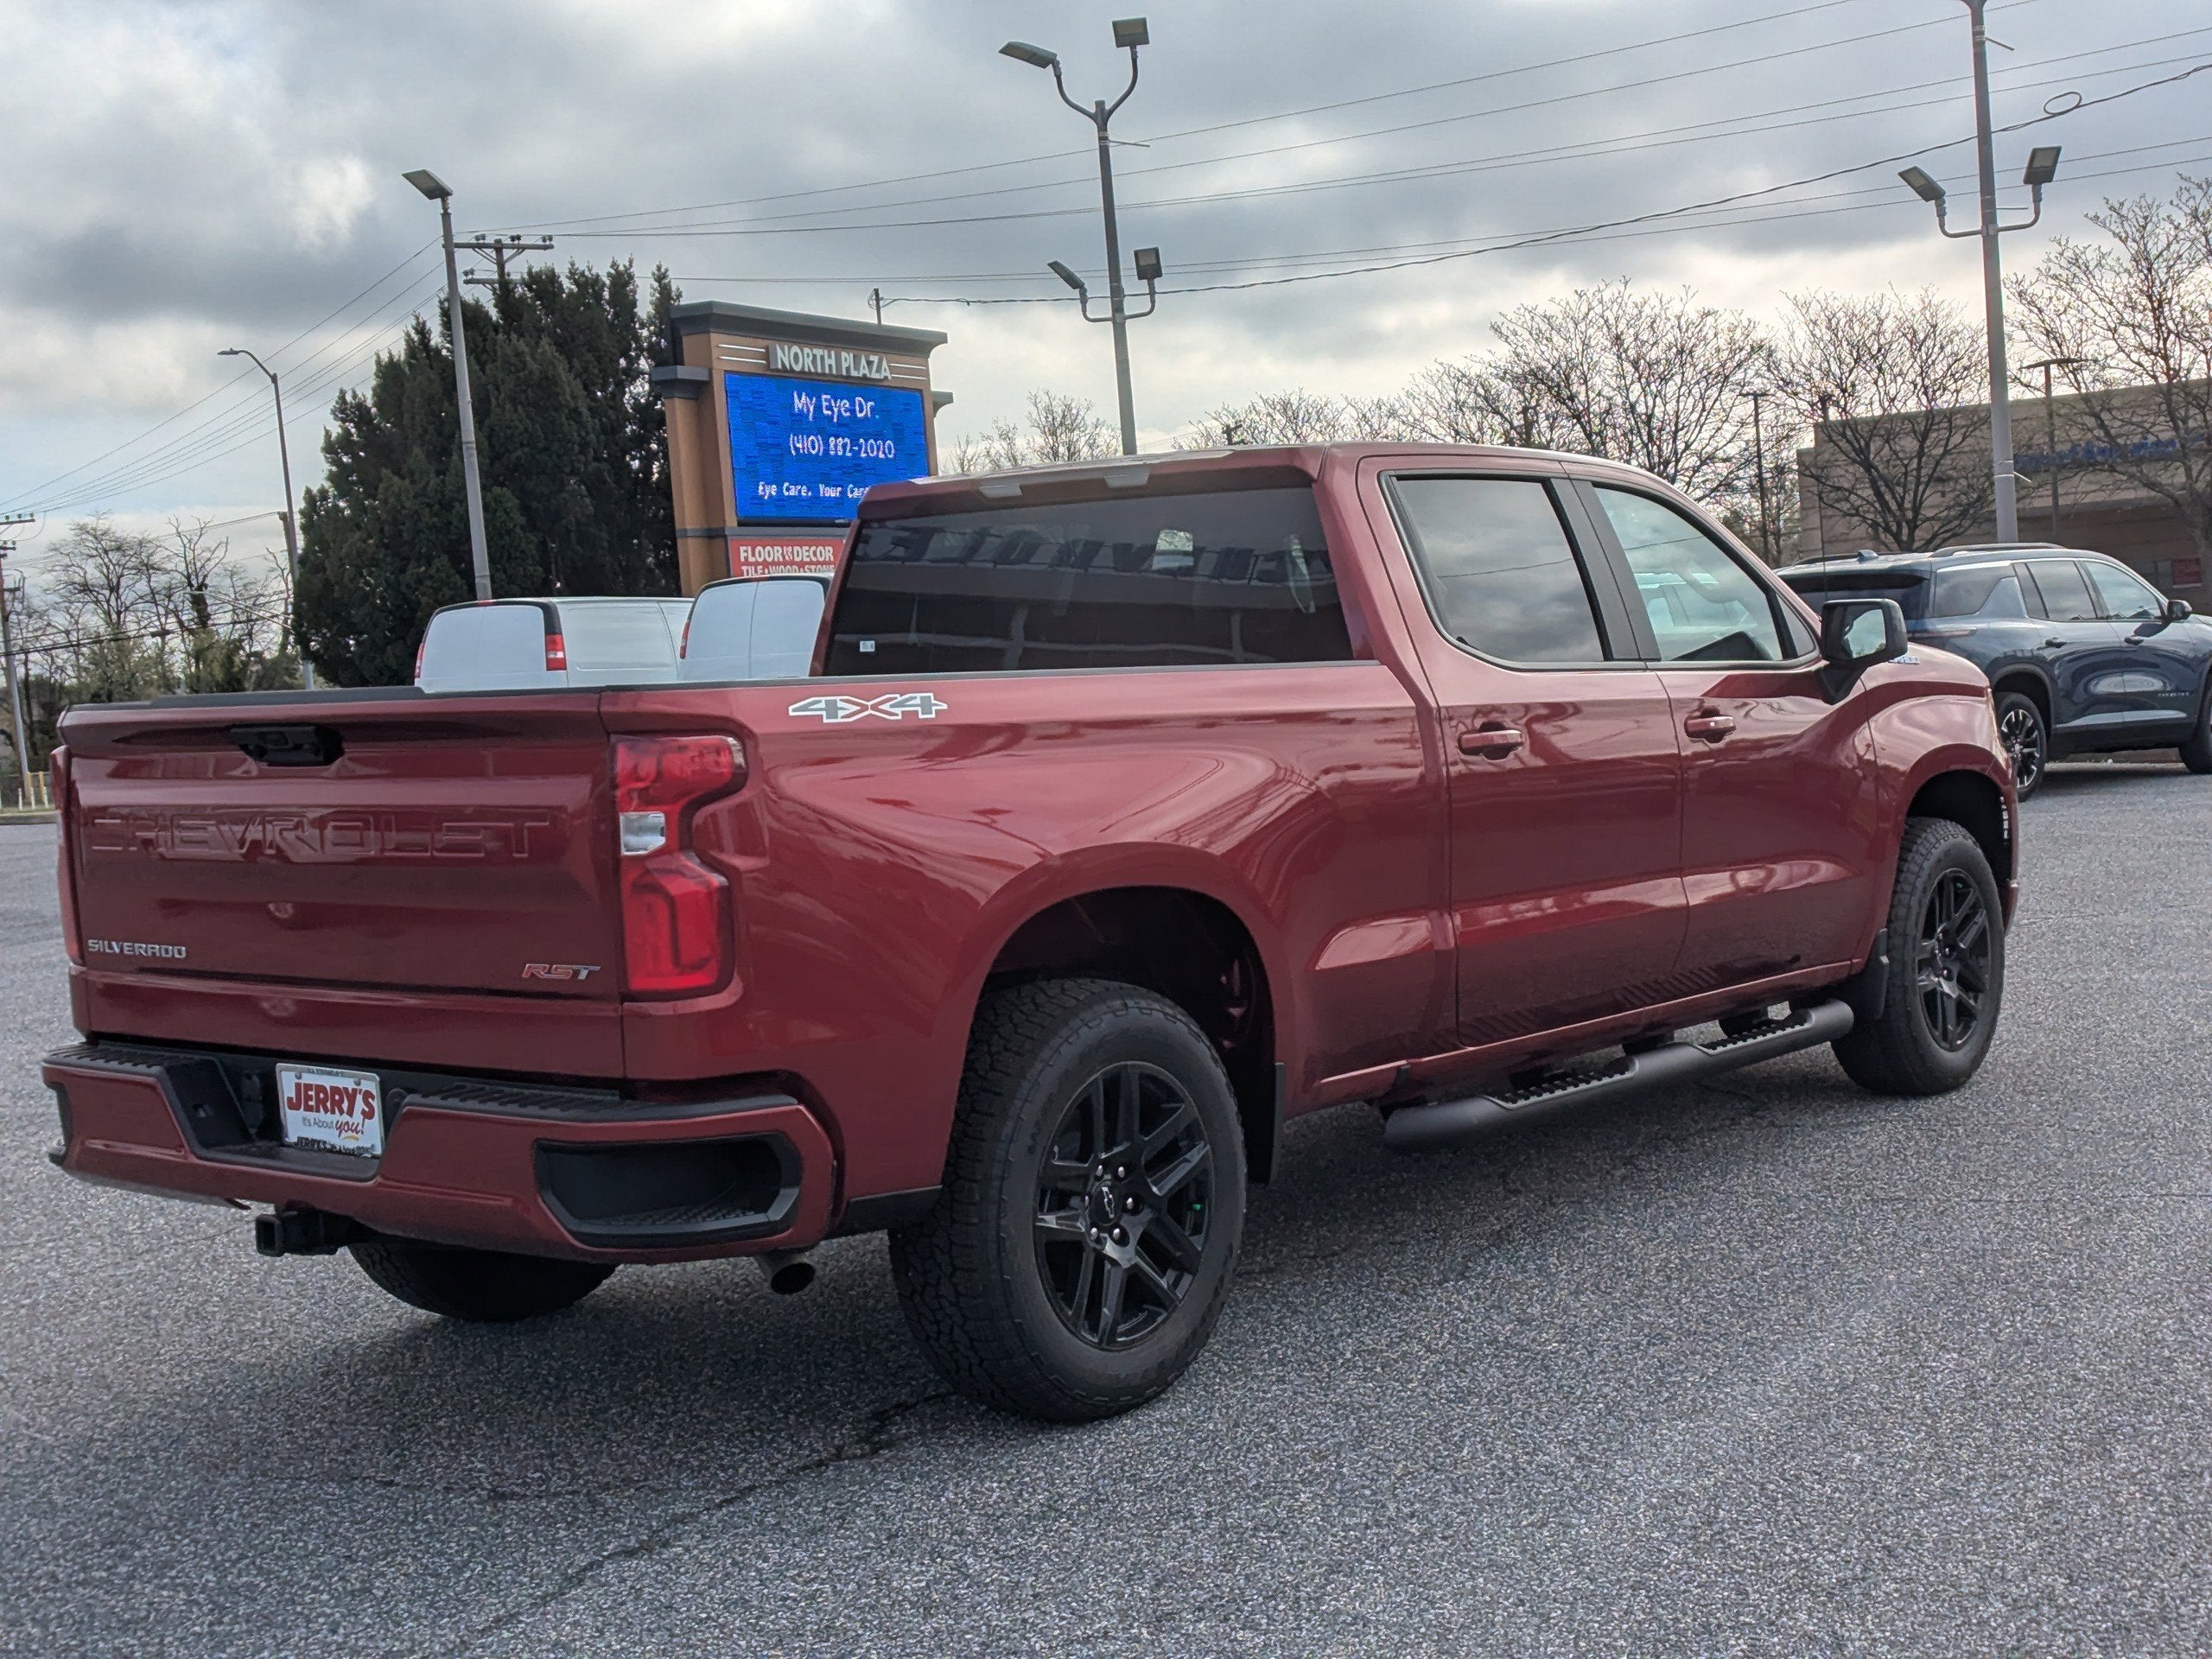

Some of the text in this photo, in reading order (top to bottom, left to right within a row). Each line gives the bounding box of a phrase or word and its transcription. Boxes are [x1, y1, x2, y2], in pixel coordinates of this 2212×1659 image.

[776, 344, 892, 380] NORTH PLAZA
[792, 391, 816, 422] My
[822, 394, 850, 423] Eye
[788, 433, 895, 459] (410) 882-2020
[757, 481, 777, 499] Eye
[782, 482, 812, 496] Care.
[818, 483, 842, 497] Your
[740, 545, 783, 562] FLOOR
[793, 546, 834, 562] DECOR
[90, 814, 550, 857] CHEVROLET
[87, 938, 187, 959] SILVERADO
[521, 963, 601, 981] RST
[286, 1082, 375, 1120] JERRY'S
[334, 1117, 364, 1138] you!
